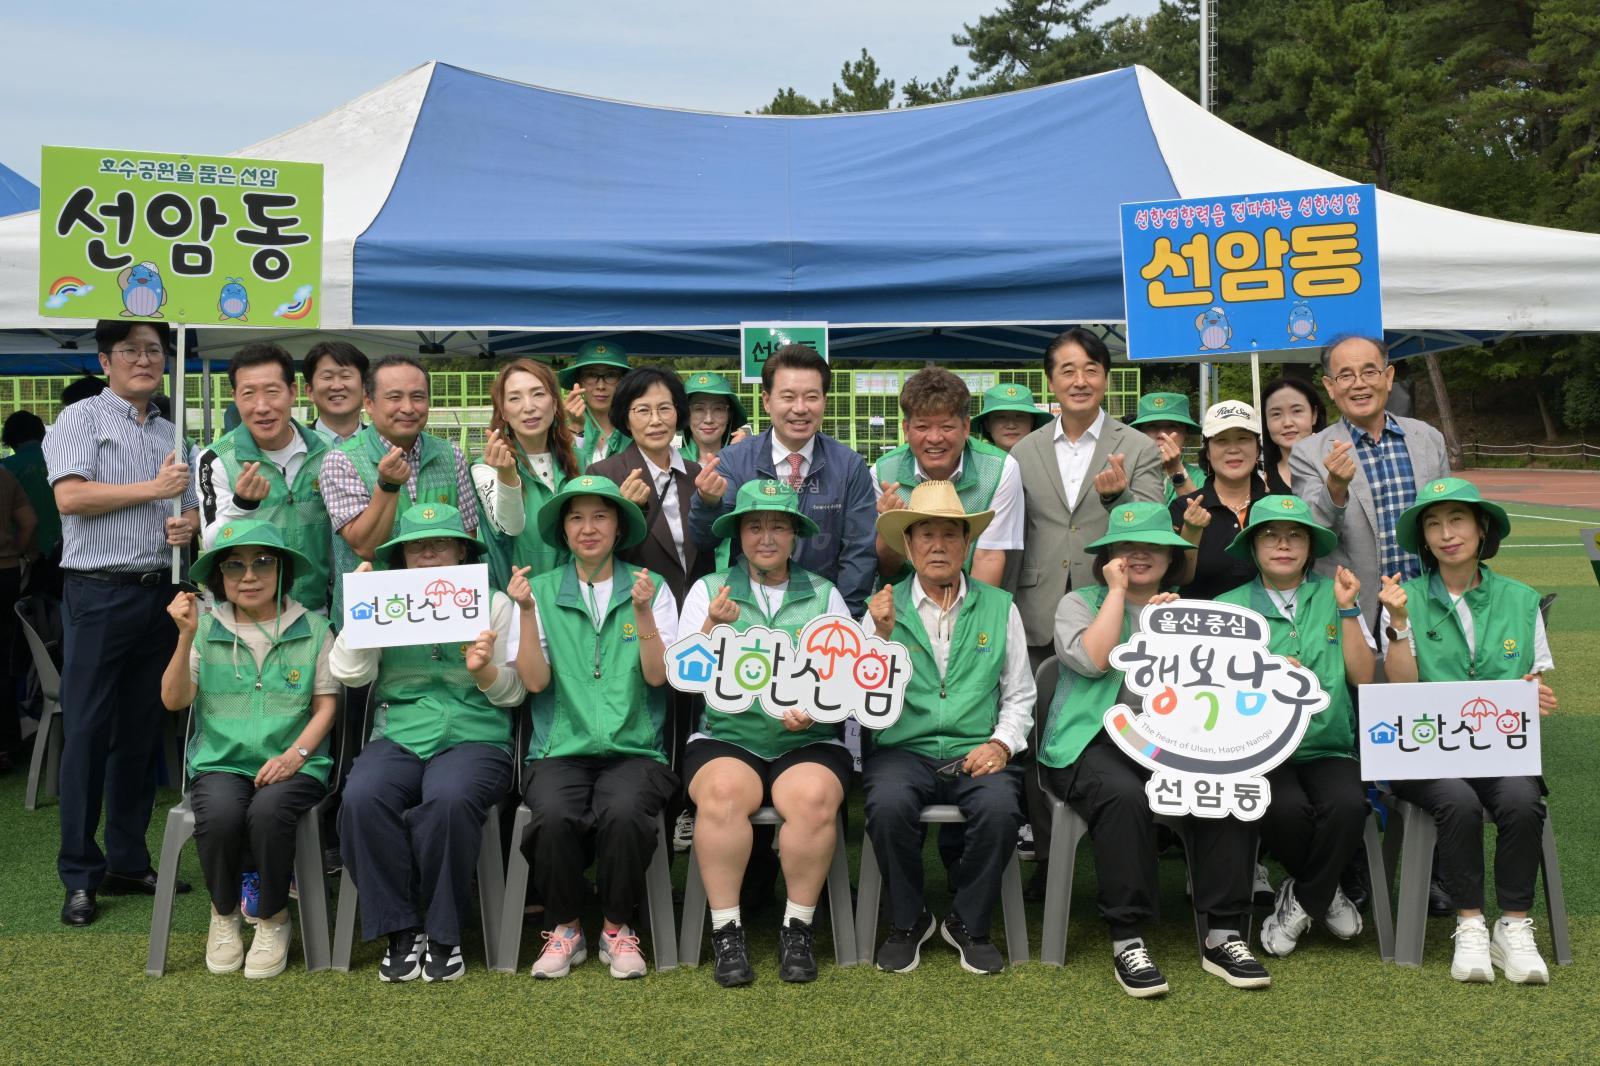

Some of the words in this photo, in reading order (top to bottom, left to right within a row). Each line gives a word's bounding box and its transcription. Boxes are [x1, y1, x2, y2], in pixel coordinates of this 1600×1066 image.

[100, 158, 195, 183] 호수공원을
[199, 165, 236, 185] 품은
[240, 168, 278, 187] 선암
[1135, 203, 1225, 230] 선한영향력을
[1298, 193, 1360, 216] 선한선암
[57, 187, 310, 280] 선암동
[1140, 222, 1362, 308] 선암동
[1158, 611, 1201, 633] 울산
[1204, 614, 1246, 637] 중심
[1119, 640, 1322, 731] 행복남구
[1141, 722, 1155, 735] The
[1156, 729, 1177, 747] heart
[1219, 744, 1245, 754] Happy
[1246, 728, 1273, 747] Namgu
[1155, 778, 1262, 812] 선암동
